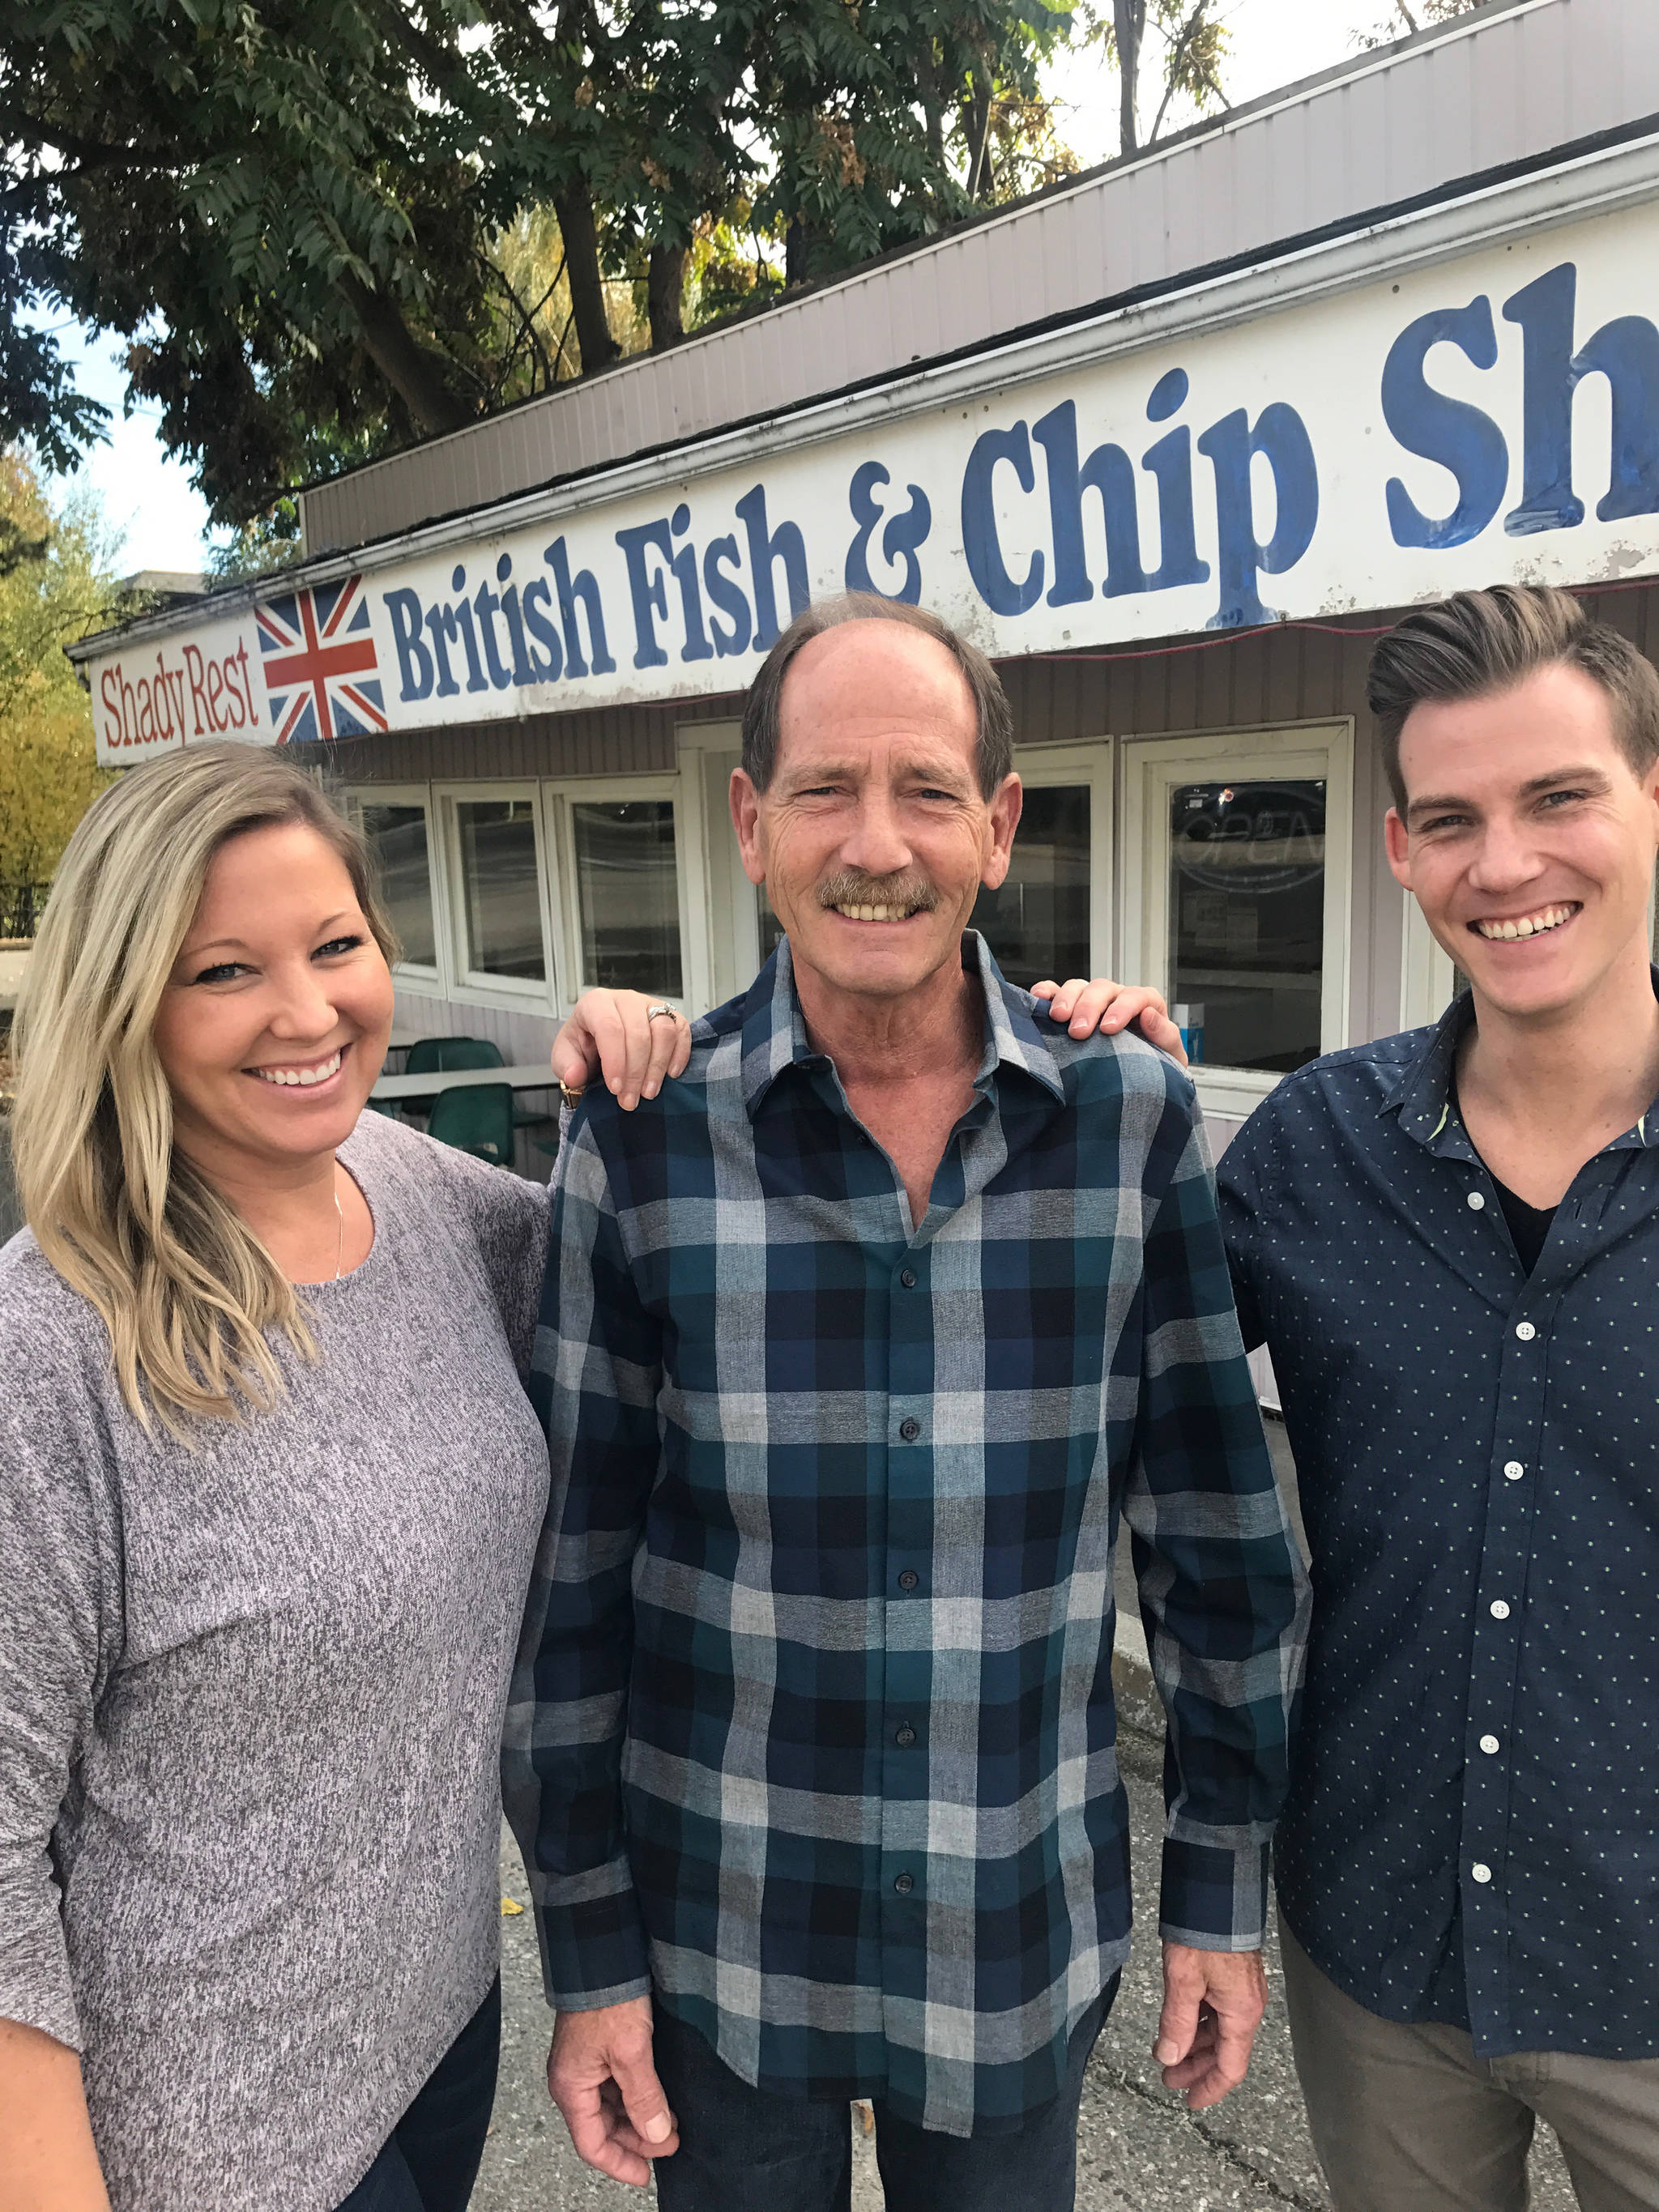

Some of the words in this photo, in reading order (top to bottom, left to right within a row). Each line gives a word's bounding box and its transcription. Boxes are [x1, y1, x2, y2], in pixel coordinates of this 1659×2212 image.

[382, 535, 616, 702] British
[615, 483, 810, 670] Fish
[844, 461, 932, 606] &
[961, 367, 1320, 629] Chip
[1381, 262, 1659, 549] Sh
[101, 663, 186, 748] Shady
[182, 635, 258, 735] Rest
